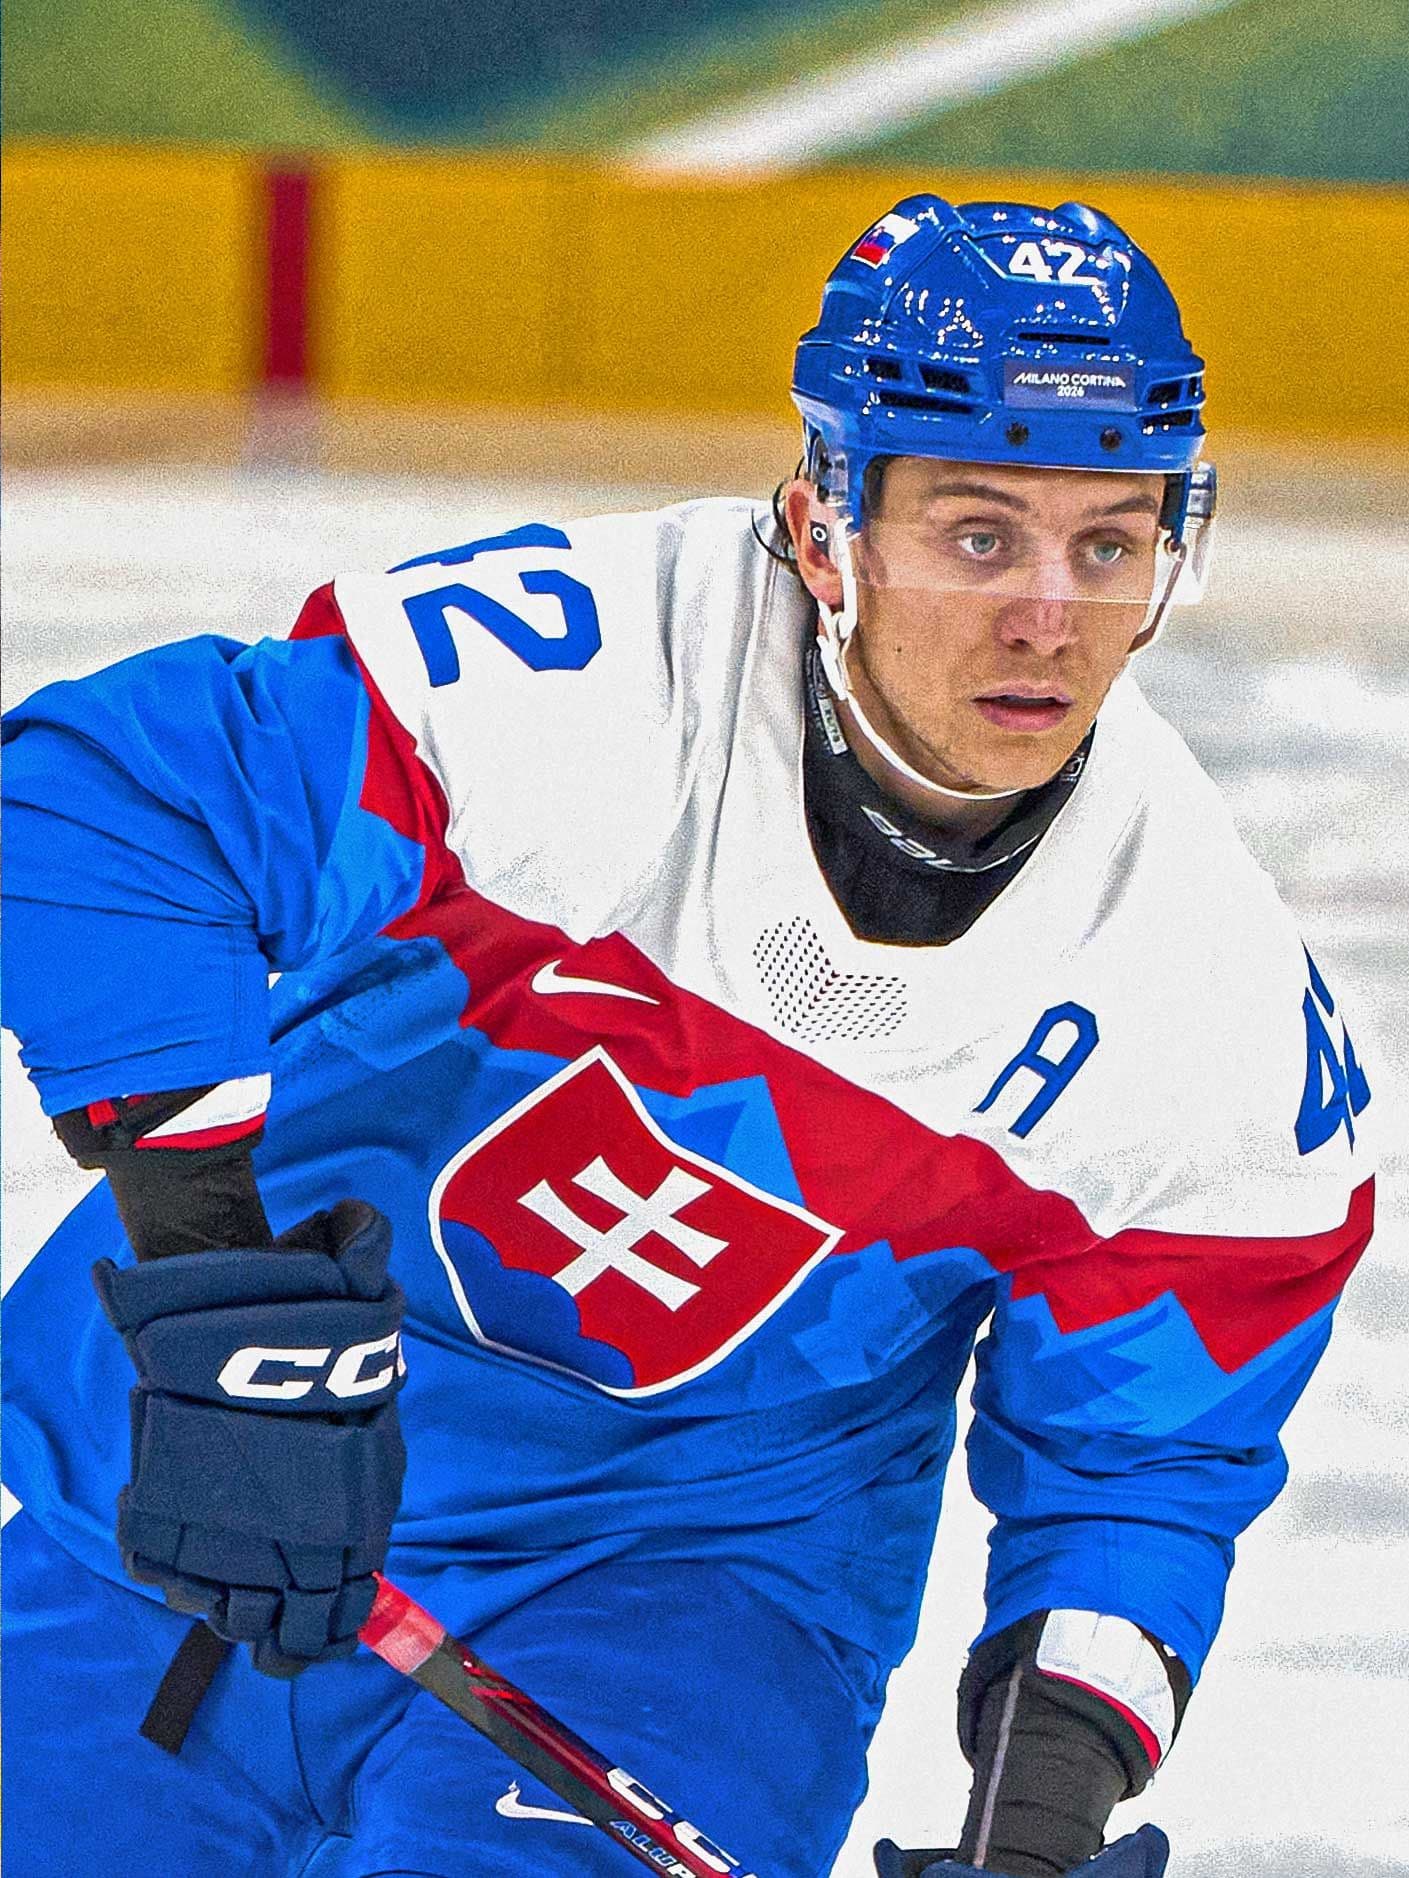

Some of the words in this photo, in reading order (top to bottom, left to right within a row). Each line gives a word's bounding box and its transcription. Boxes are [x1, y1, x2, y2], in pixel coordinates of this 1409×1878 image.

[1008, 241, 1099, 285] 42
[1013, 372, 1070, 386] MILANO
[1071, 373, 1126, 388] CORTINA
[1056, 385, 1085, 397] 2026
[971, 1000, 1100, 1140] A
[216, 1330, 407, 1400] CC
[606, 1767, 757, 1878] CC
